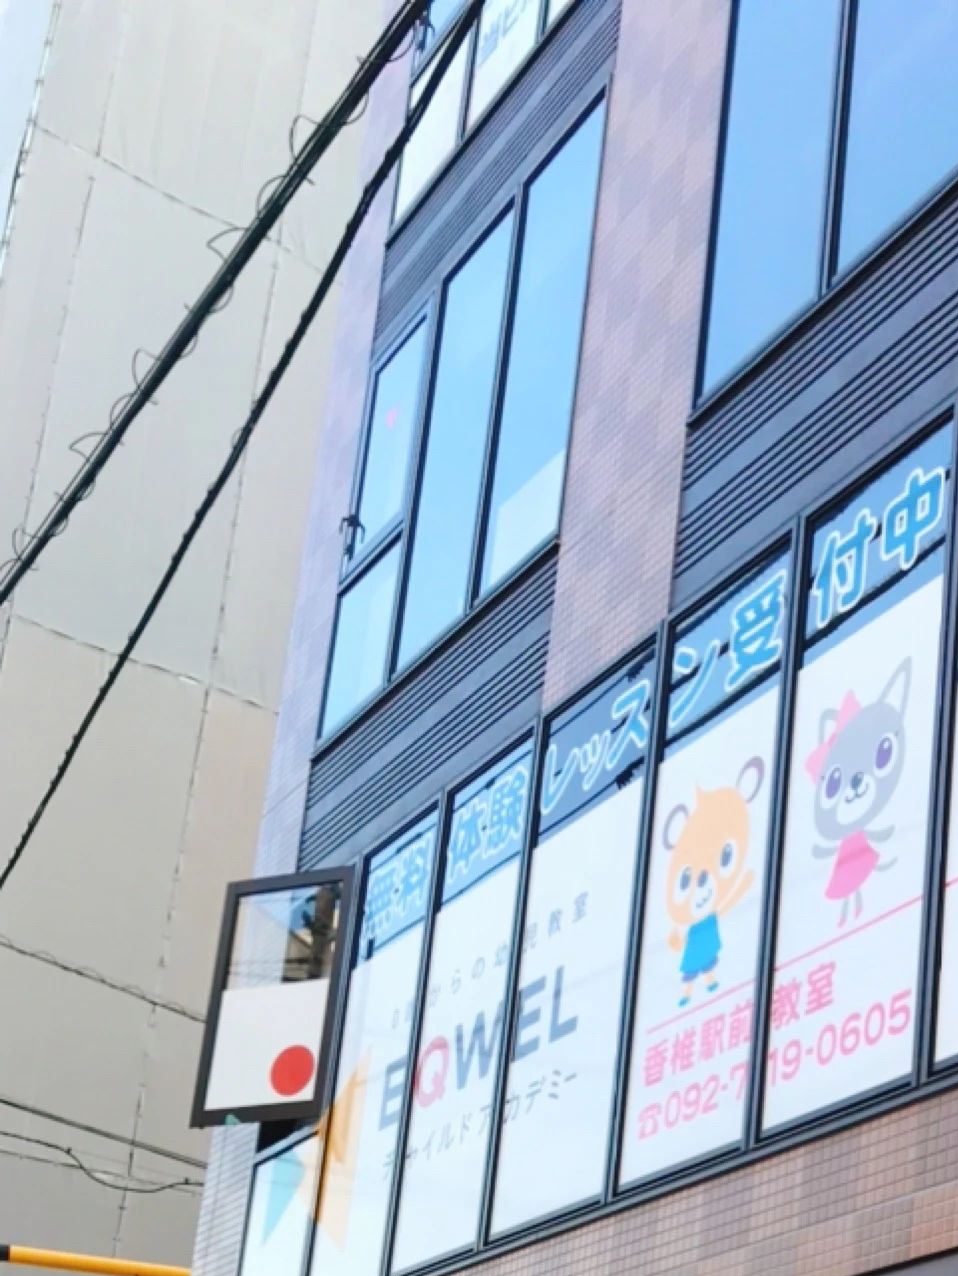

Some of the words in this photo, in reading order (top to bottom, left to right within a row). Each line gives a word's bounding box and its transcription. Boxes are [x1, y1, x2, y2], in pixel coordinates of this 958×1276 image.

[378, 965, 578, 1132] EQWEL
[643, 961, 836, 1088] 香椎駅前教室
